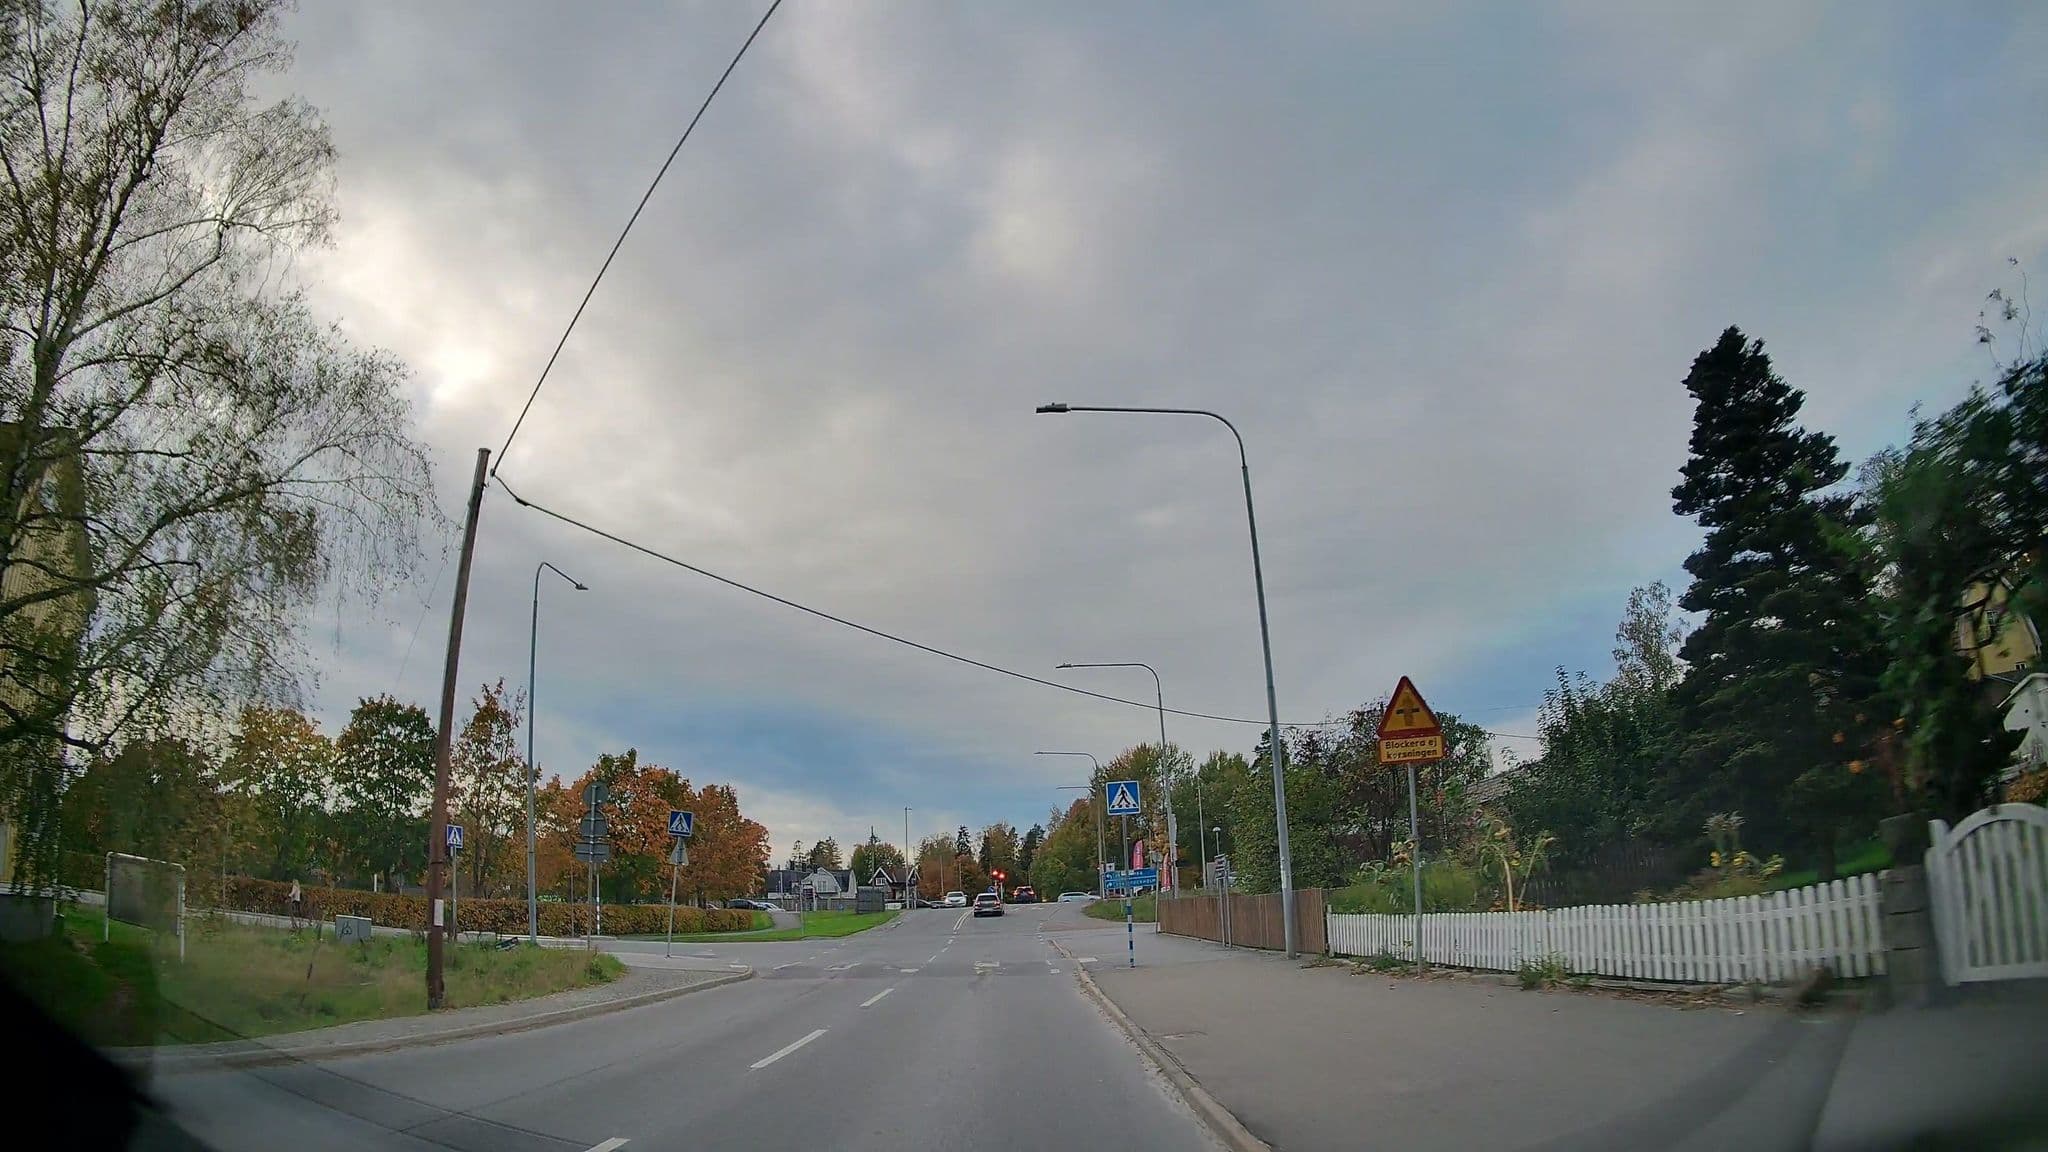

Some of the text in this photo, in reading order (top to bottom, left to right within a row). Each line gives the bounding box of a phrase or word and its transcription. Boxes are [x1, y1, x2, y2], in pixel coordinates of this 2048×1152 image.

[1385, 737, 1437, 749] Blockera ej
[1386, 749, 1438, 759] korsningen
